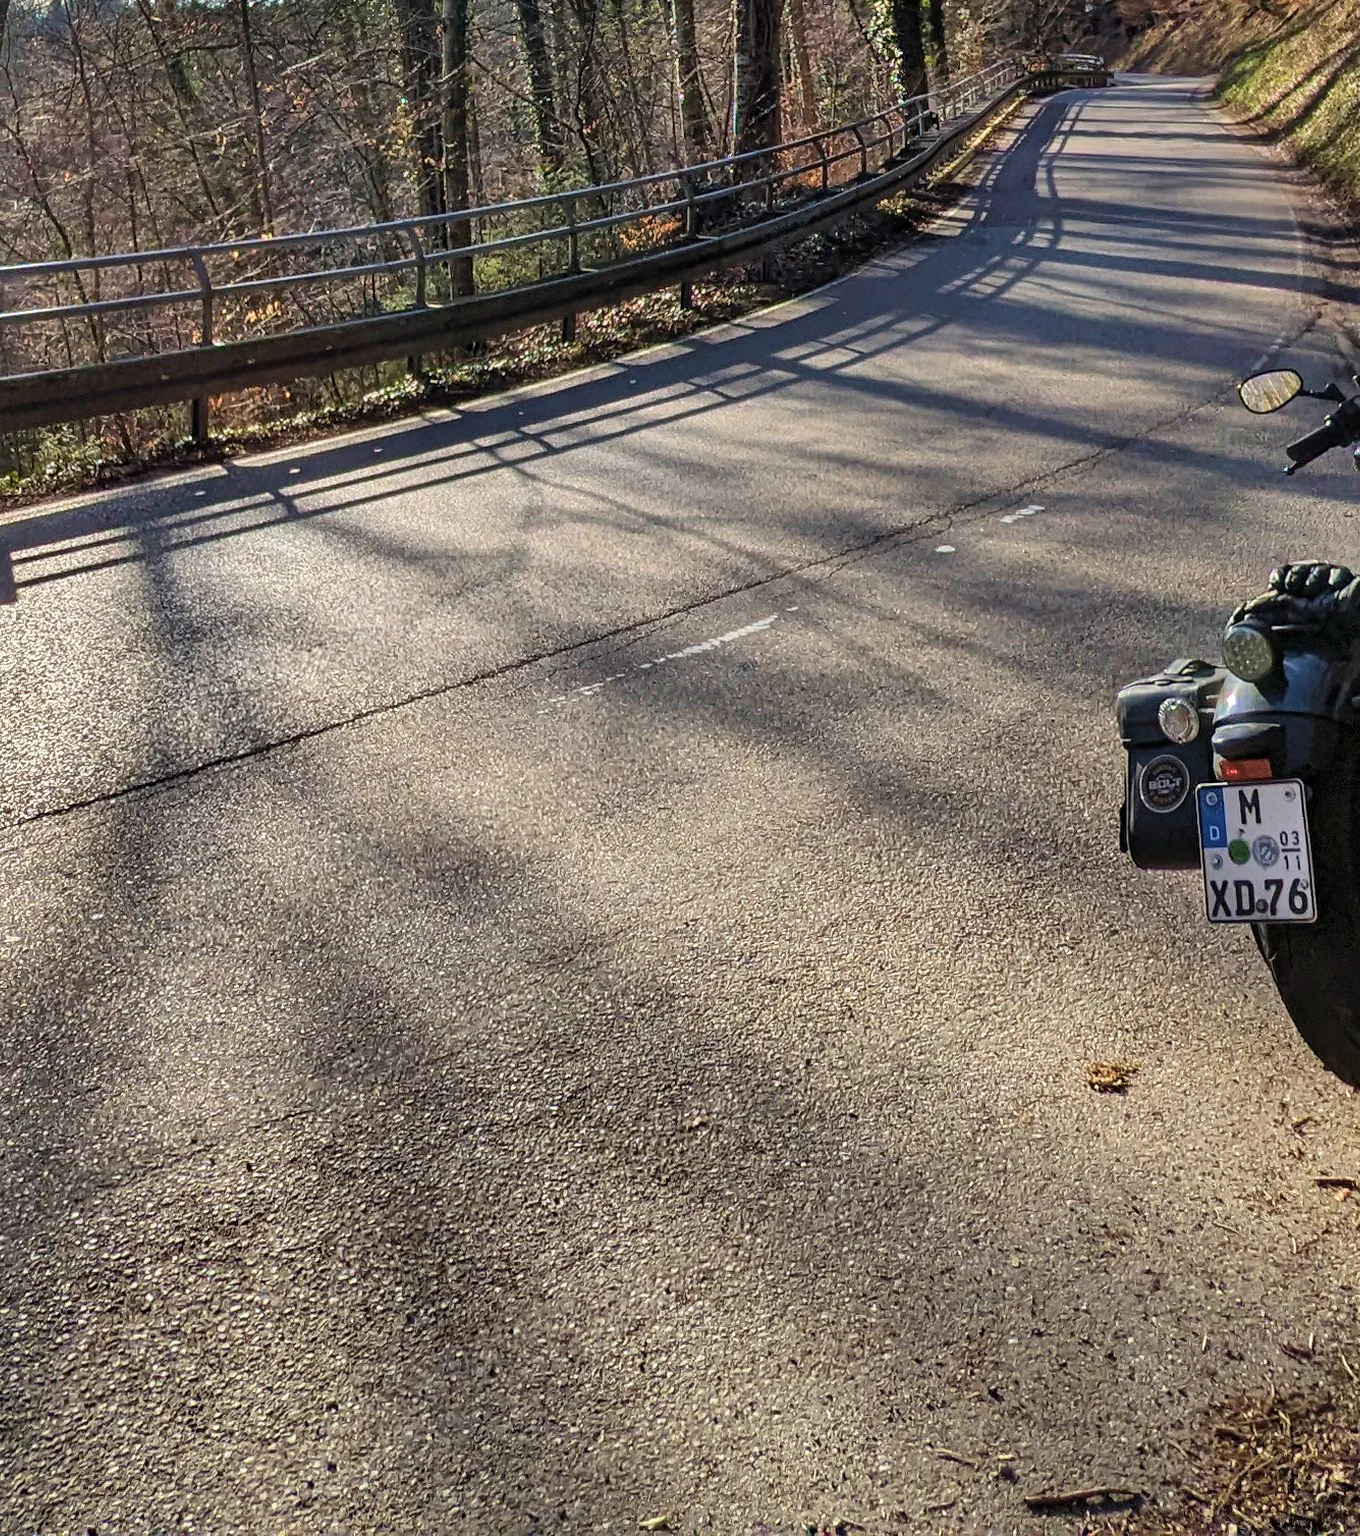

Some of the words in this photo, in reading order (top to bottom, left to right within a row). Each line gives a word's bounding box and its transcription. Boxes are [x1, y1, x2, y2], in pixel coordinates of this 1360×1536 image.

[1237, 787, 1262, 825] M
[1210, 825, 1221, 842] D
[1278, 830, 1301, 846] 03
[1282, 854, 1302, 871] 11
[1210, 880, 1256, 918] XD
[1264, 878, 1309, 916] 76
